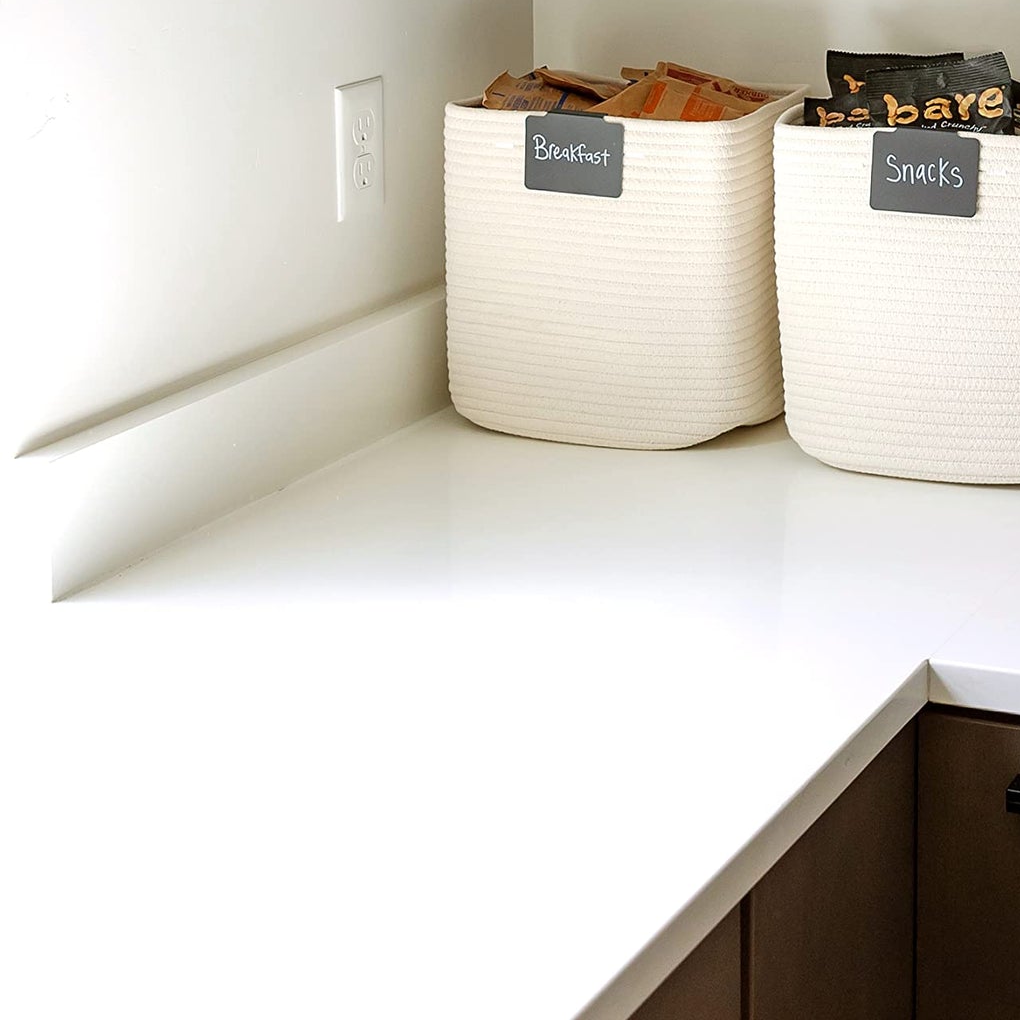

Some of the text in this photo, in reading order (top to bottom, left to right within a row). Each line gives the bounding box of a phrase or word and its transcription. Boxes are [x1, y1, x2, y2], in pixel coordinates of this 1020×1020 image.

[816, 106, 870, 127] ba
[883, 87, 1004, 127] bare
[940, 120, 983, 133] Crunchy
[532, 134, 611, 167] Breakfast
[885, 154, 964, 188] Snacks
